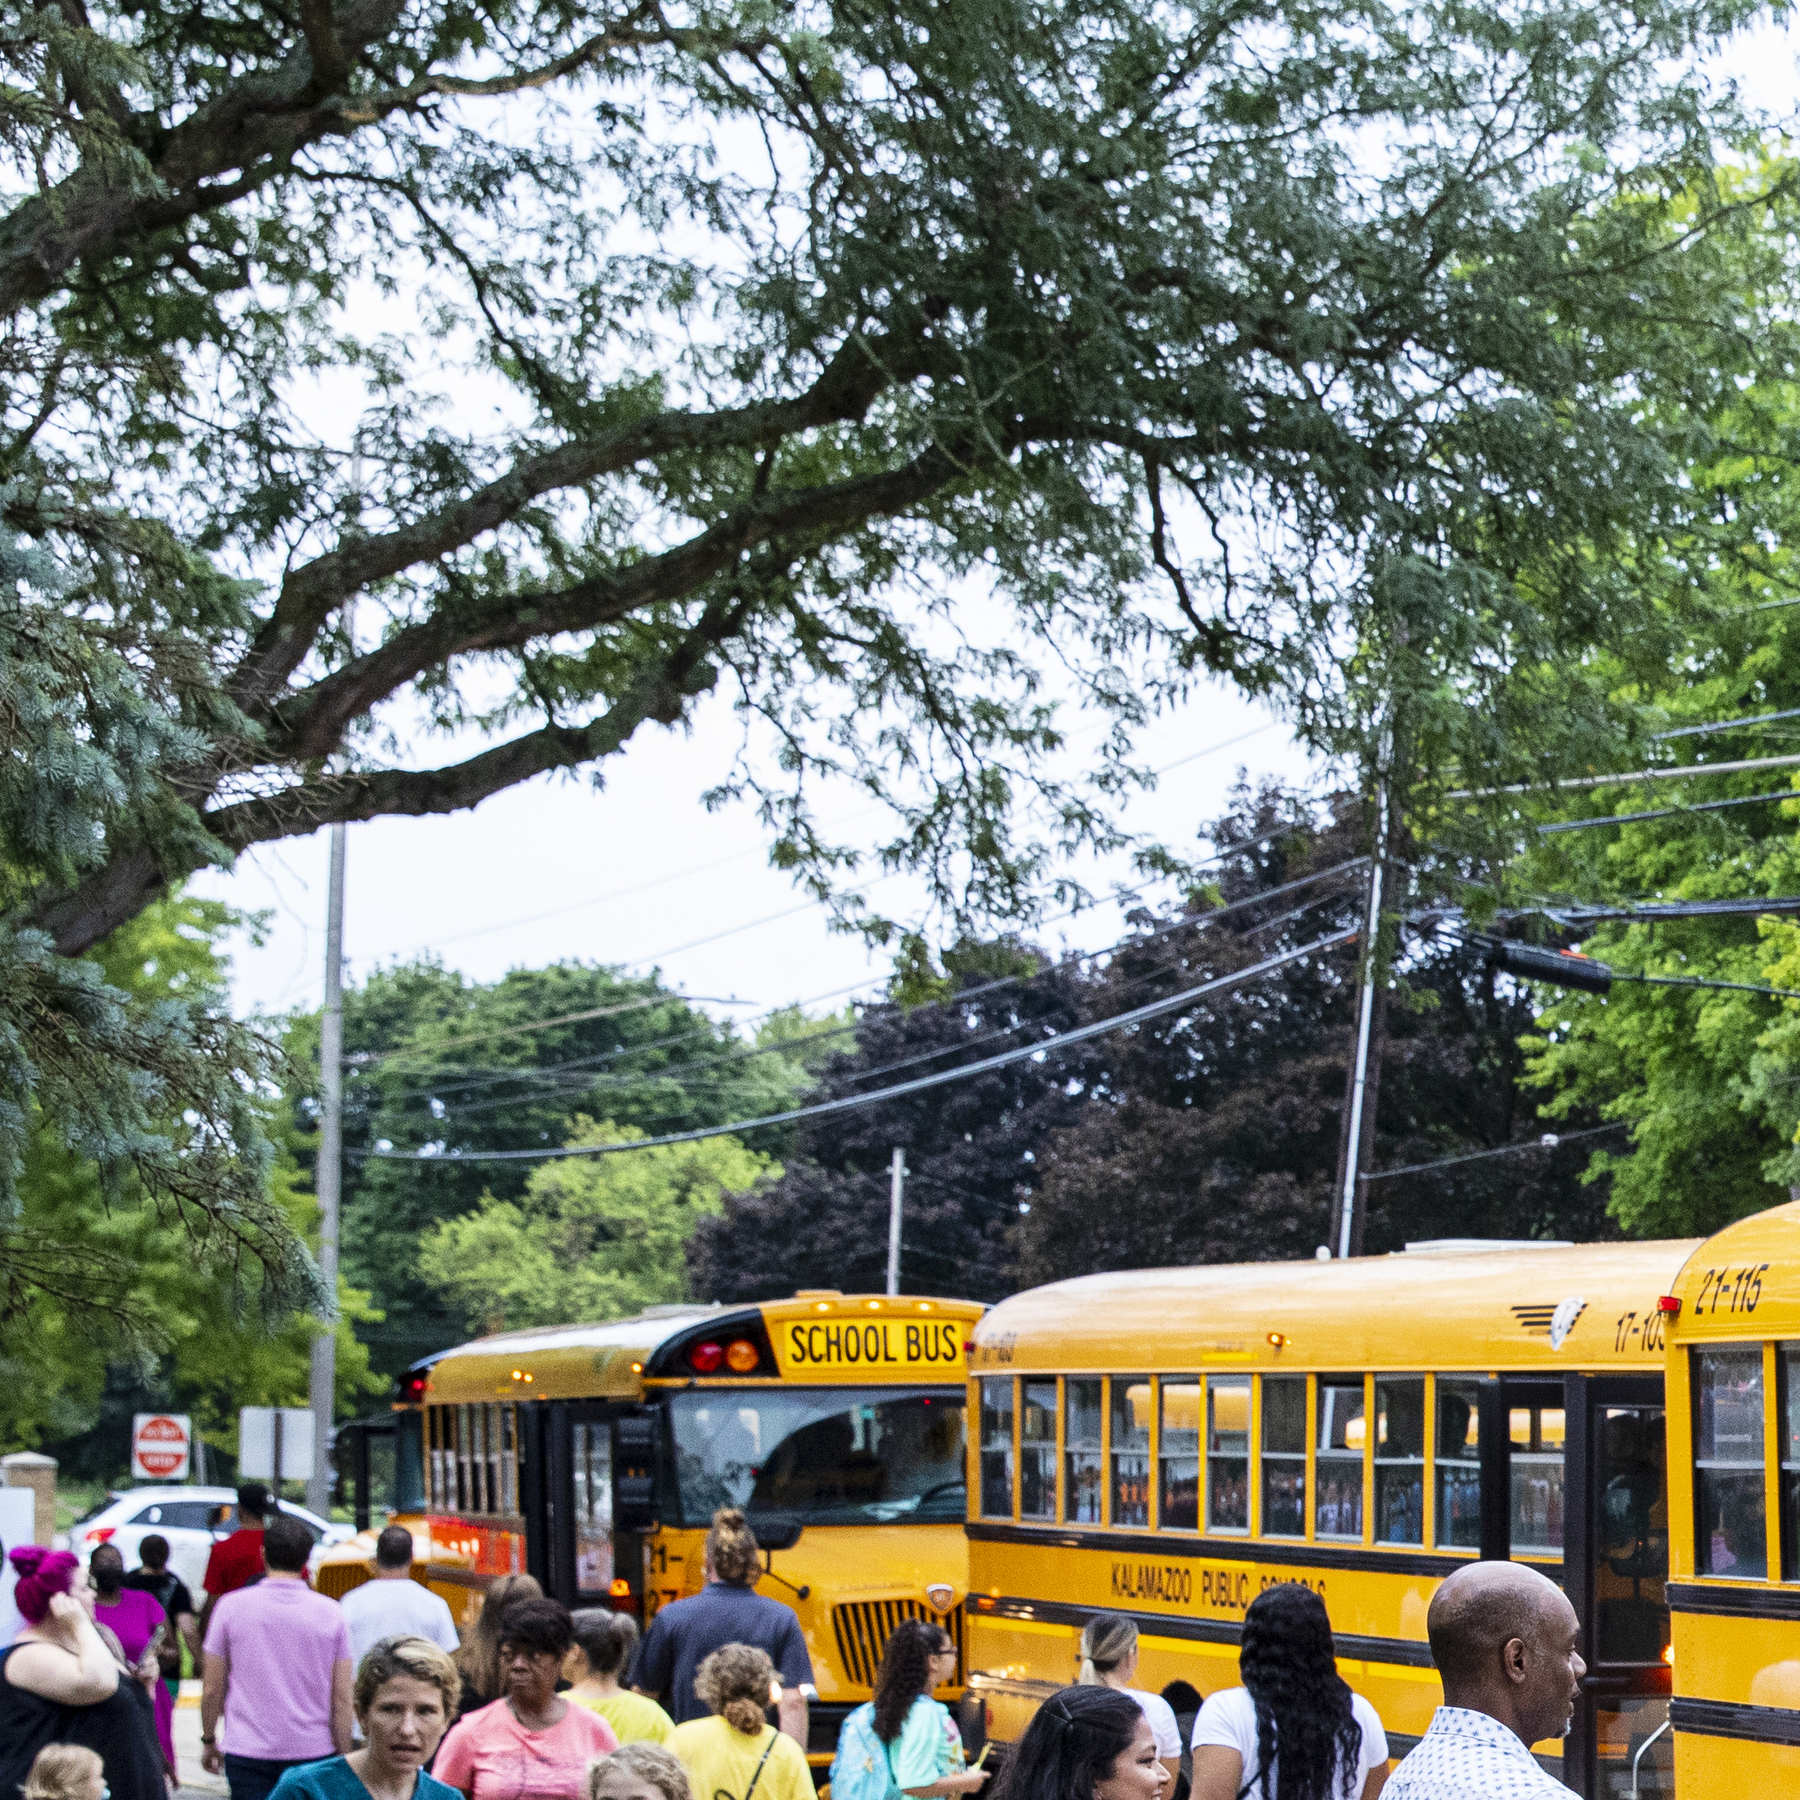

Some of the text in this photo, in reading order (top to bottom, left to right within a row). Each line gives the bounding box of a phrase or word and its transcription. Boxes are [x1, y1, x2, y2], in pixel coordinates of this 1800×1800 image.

[1695, 1264, 1769, 1315] 21-115
[791, 1324, 957, 1363] SCHOOL BUS
[1111, 1563, 1192, 1603] KALAMAZOO
[1202, 1570, 1248, 1609] PUBLIC
